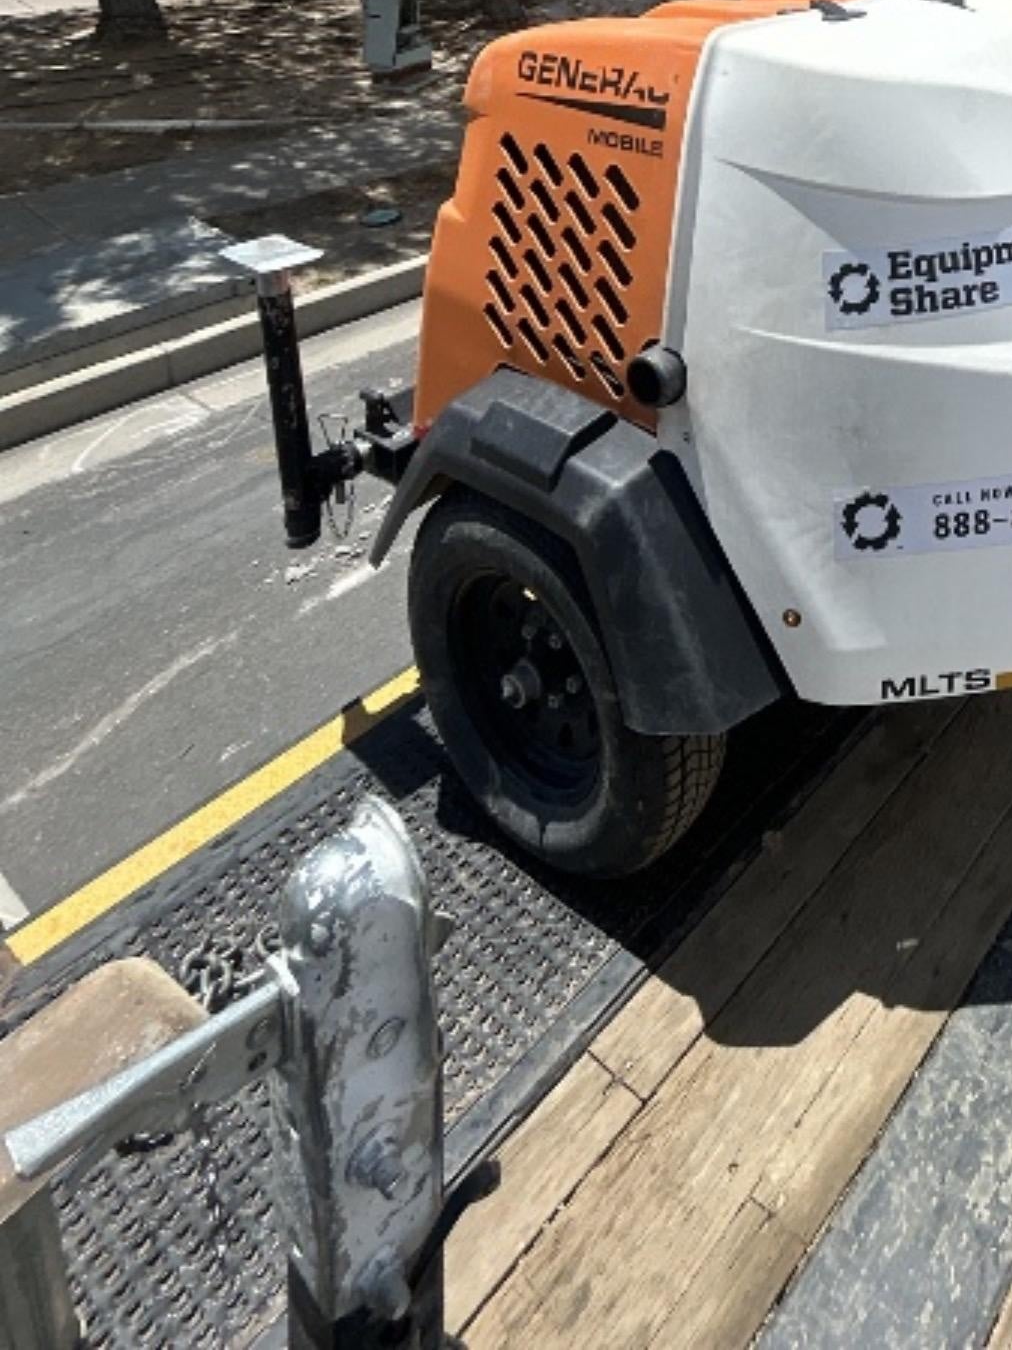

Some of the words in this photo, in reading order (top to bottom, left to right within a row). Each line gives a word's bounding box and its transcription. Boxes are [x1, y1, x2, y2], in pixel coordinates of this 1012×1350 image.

[587, 128, 664, 158] MOBILE
[888, 280, 1000, 317] Share
[932, 490, 972, 507] CALL
[881, 669, 992, 700] MLTS
